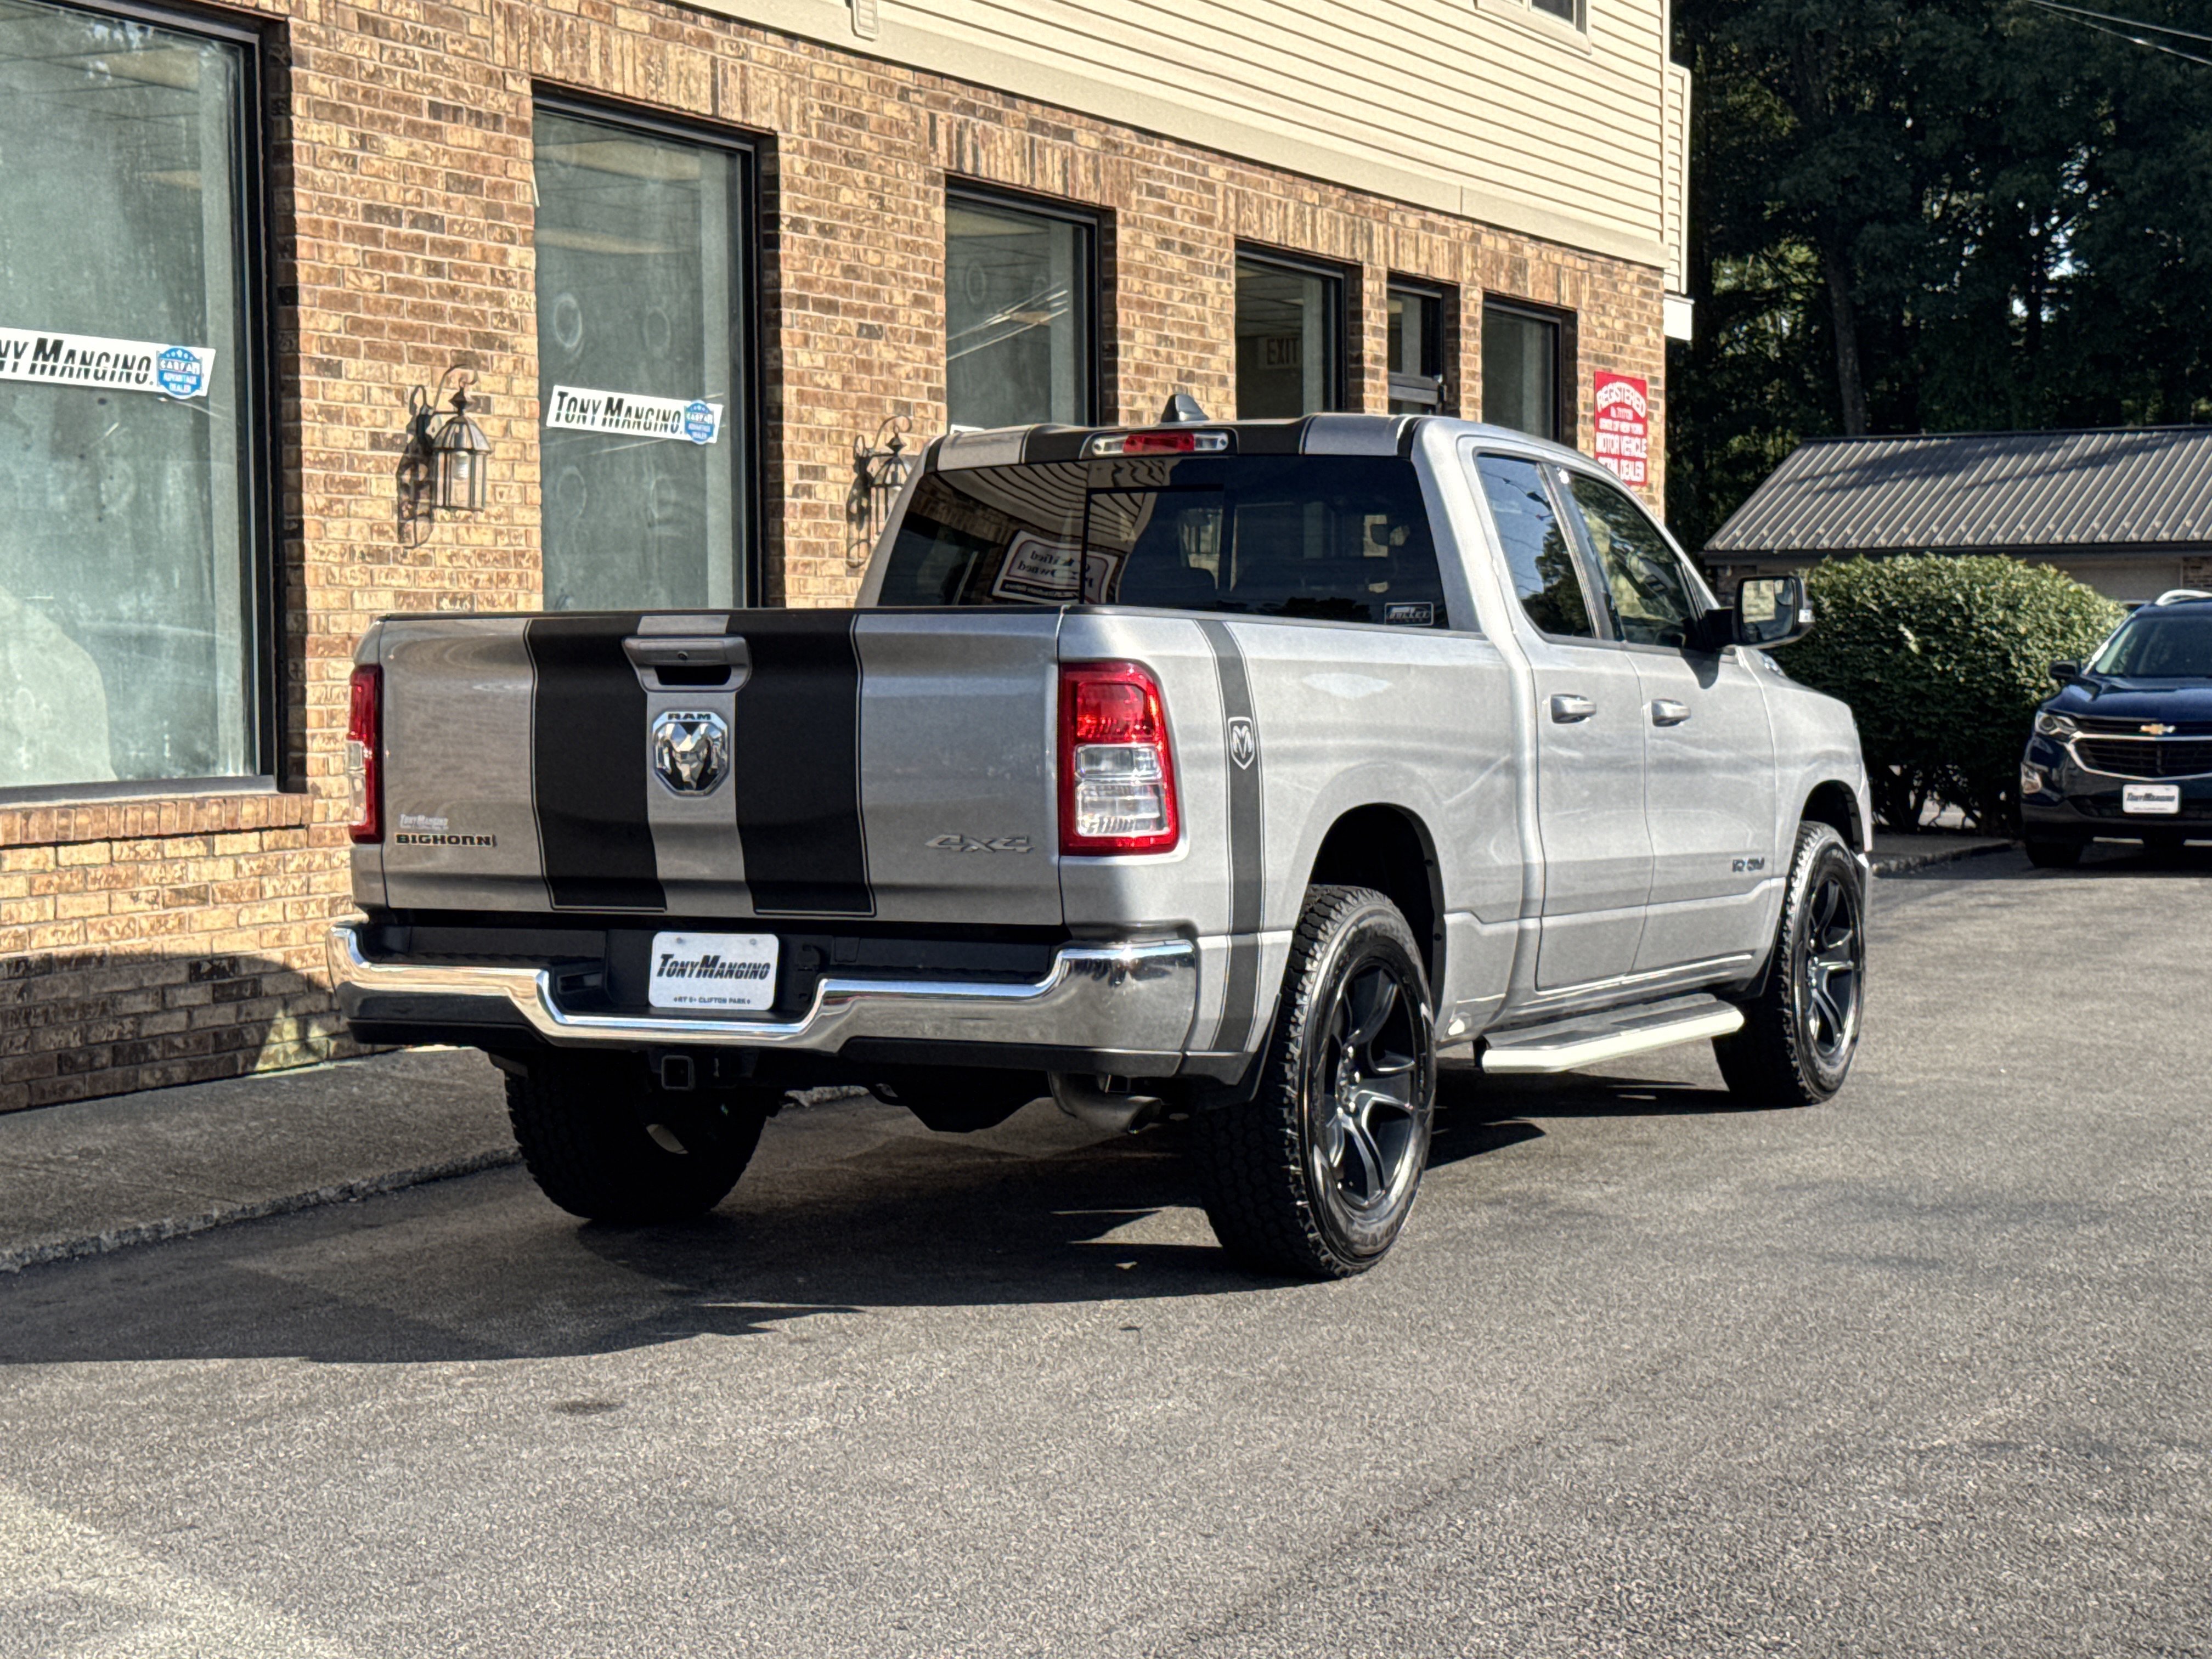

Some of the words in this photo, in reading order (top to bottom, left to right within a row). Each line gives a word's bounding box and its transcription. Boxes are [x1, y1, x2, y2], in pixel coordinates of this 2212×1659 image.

[1266, 337, 1298, 365] EXIT
[1596, 381, 1646, 419] REGISTERED
[1595, 431, 1620, 455] MOTOR
[1621, 436, 1647, 459] VEHICLE
[1620, 459, 1645, 482] DEALER
[394, 833, 493, 847] BIGHORN
[657, 953, 700, 978] TONY
